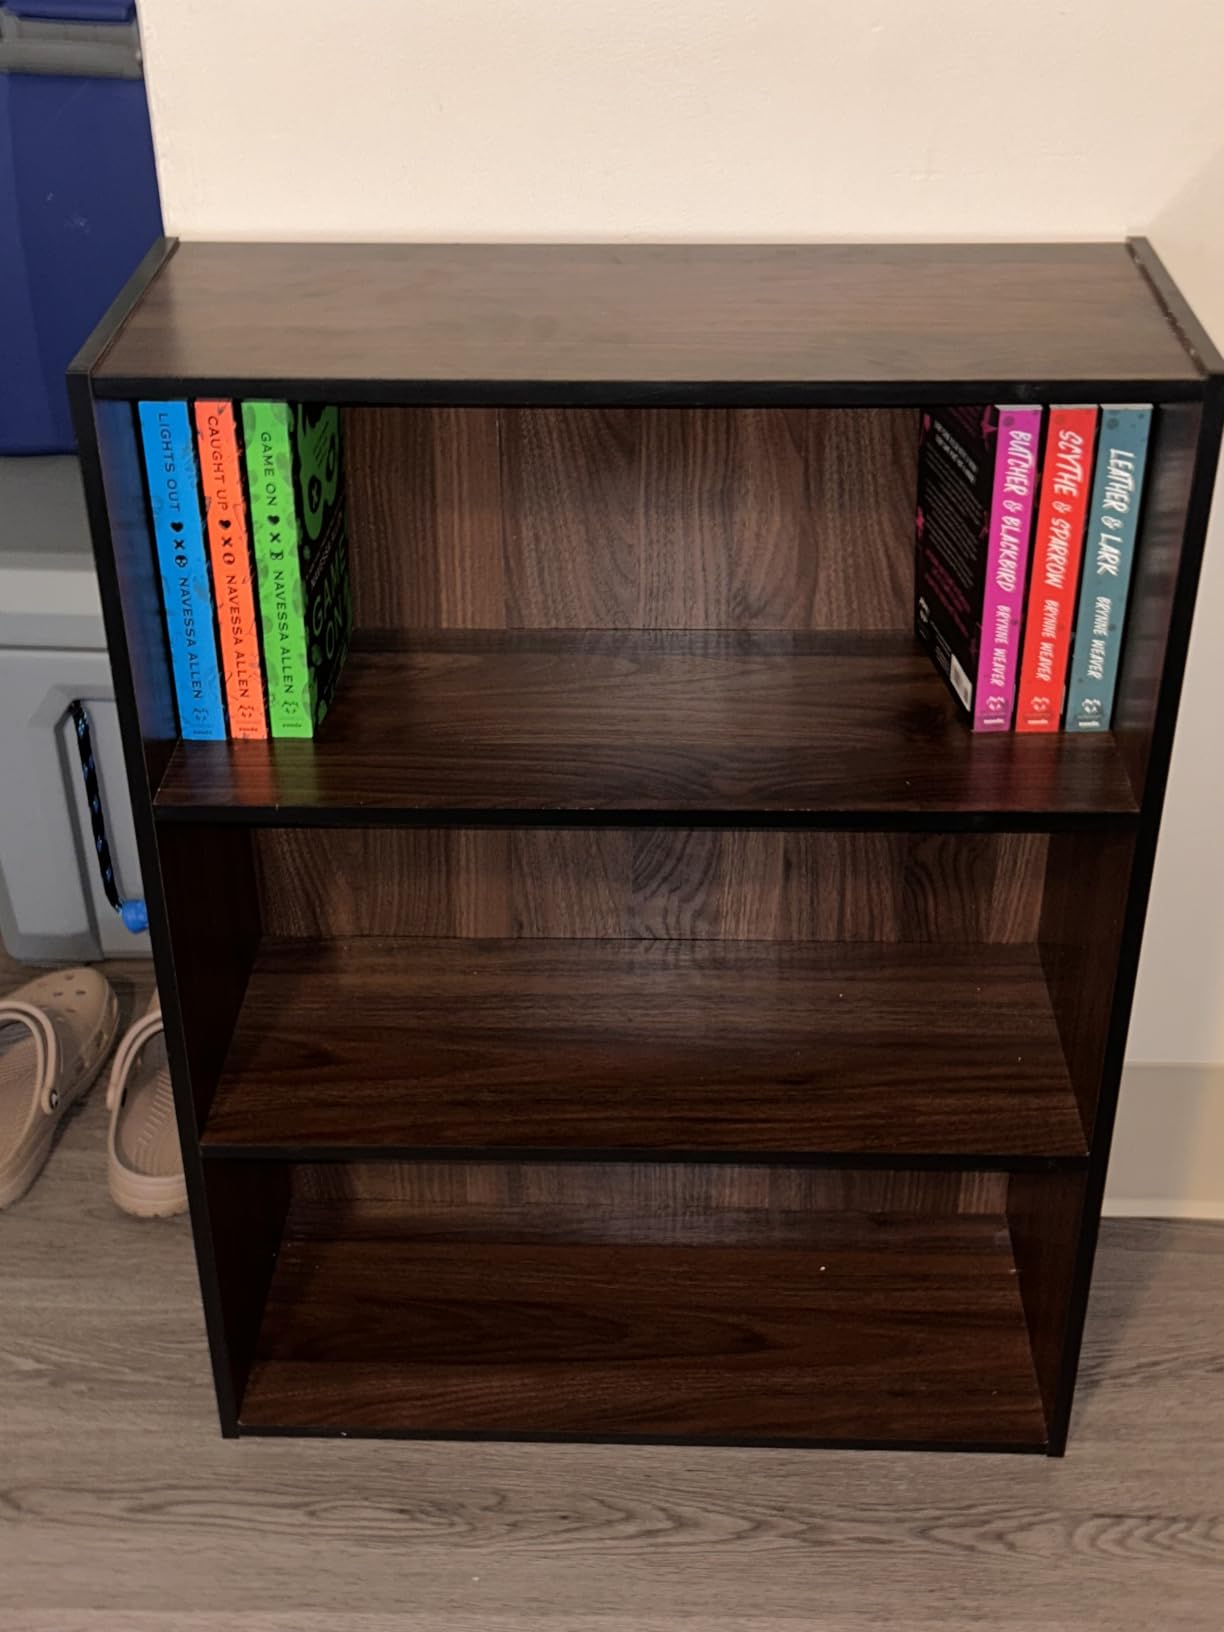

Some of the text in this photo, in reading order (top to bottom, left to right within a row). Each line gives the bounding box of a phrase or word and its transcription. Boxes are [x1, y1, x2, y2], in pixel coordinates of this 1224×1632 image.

[158, 413, 180, 512] LIGHTS OUT
[207, 415, 228, 511] CAUGHT UP
[261, 431, 277, 506] GAME ON
[996, 430, 1032, 593] BUTCHER & BLACKBIRD
[1043, 428, 1084, 590] SCYTHE & SPARROW
[1096, 447, 1137, 577] LEATHER & LARK
[273, 570, 294, 694] NAVESSA ALLEN
[312, 532, 346, 637] GAME
[325, 593, 344, 661] ON
[180, 577, 202, 699] NAVESSA ALLEN
[226, 575, 249, 698] NAVESSA ALLEN
[990, 604, 1012, 688] BRYNNE WEAVER
[1035, 599, 1060, 683] BRYNNE WEAVER
[1086, 596, 1112, 681] BRYNNE WEAVER
